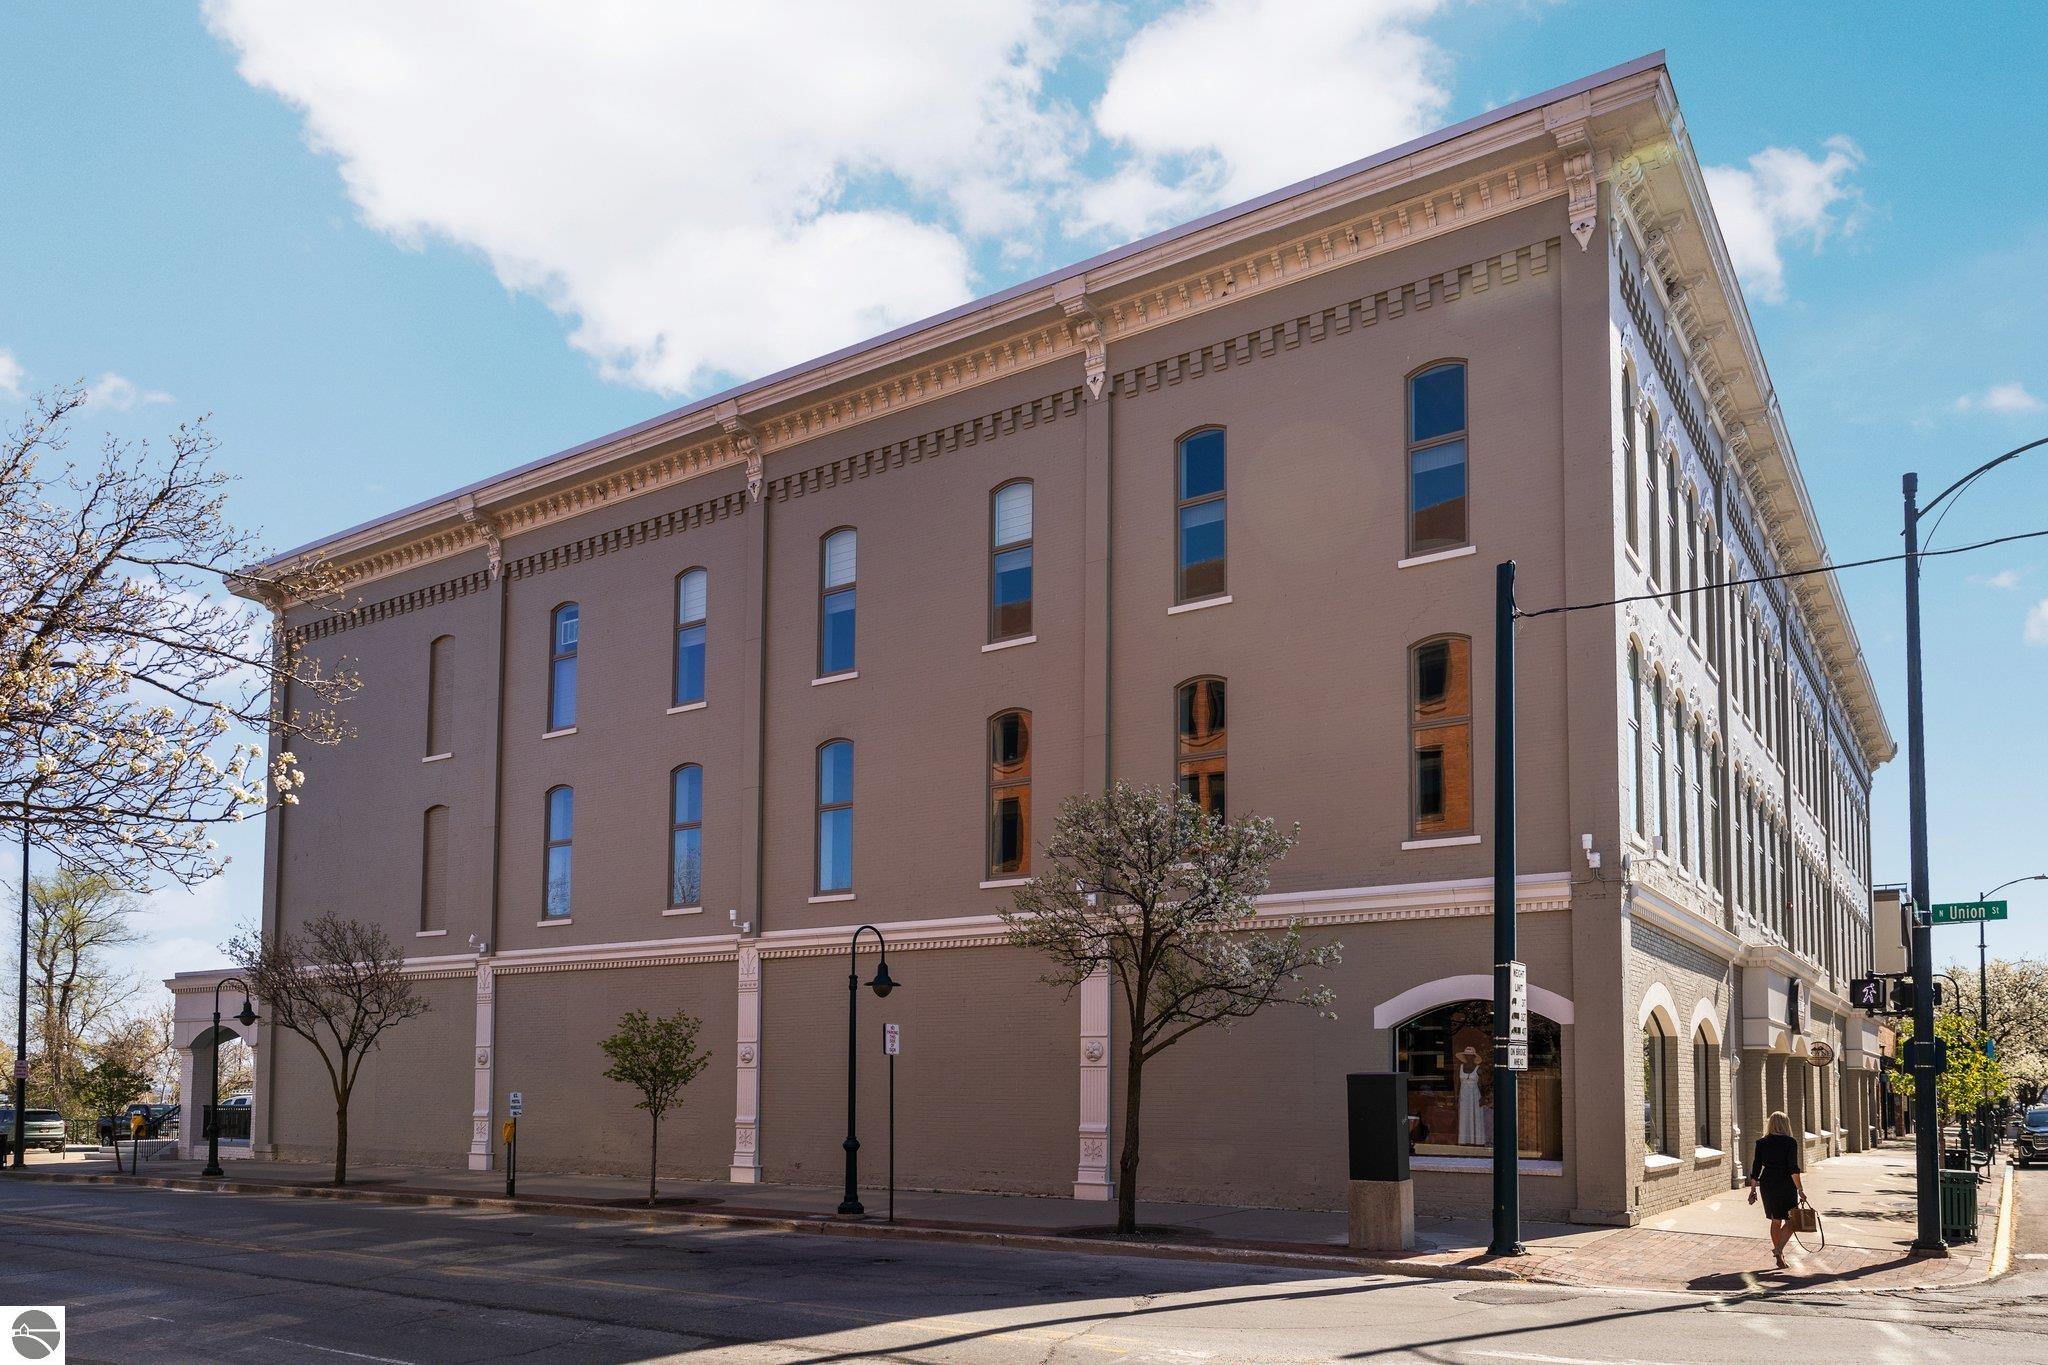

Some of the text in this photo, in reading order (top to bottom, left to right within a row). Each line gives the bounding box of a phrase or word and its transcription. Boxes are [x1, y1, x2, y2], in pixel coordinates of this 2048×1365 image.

[1949, 905, 1986, 920] Union
[1991, 906, 2000, 915] St
[1510, 1048, 1527, 1056] ON BRIDGE
